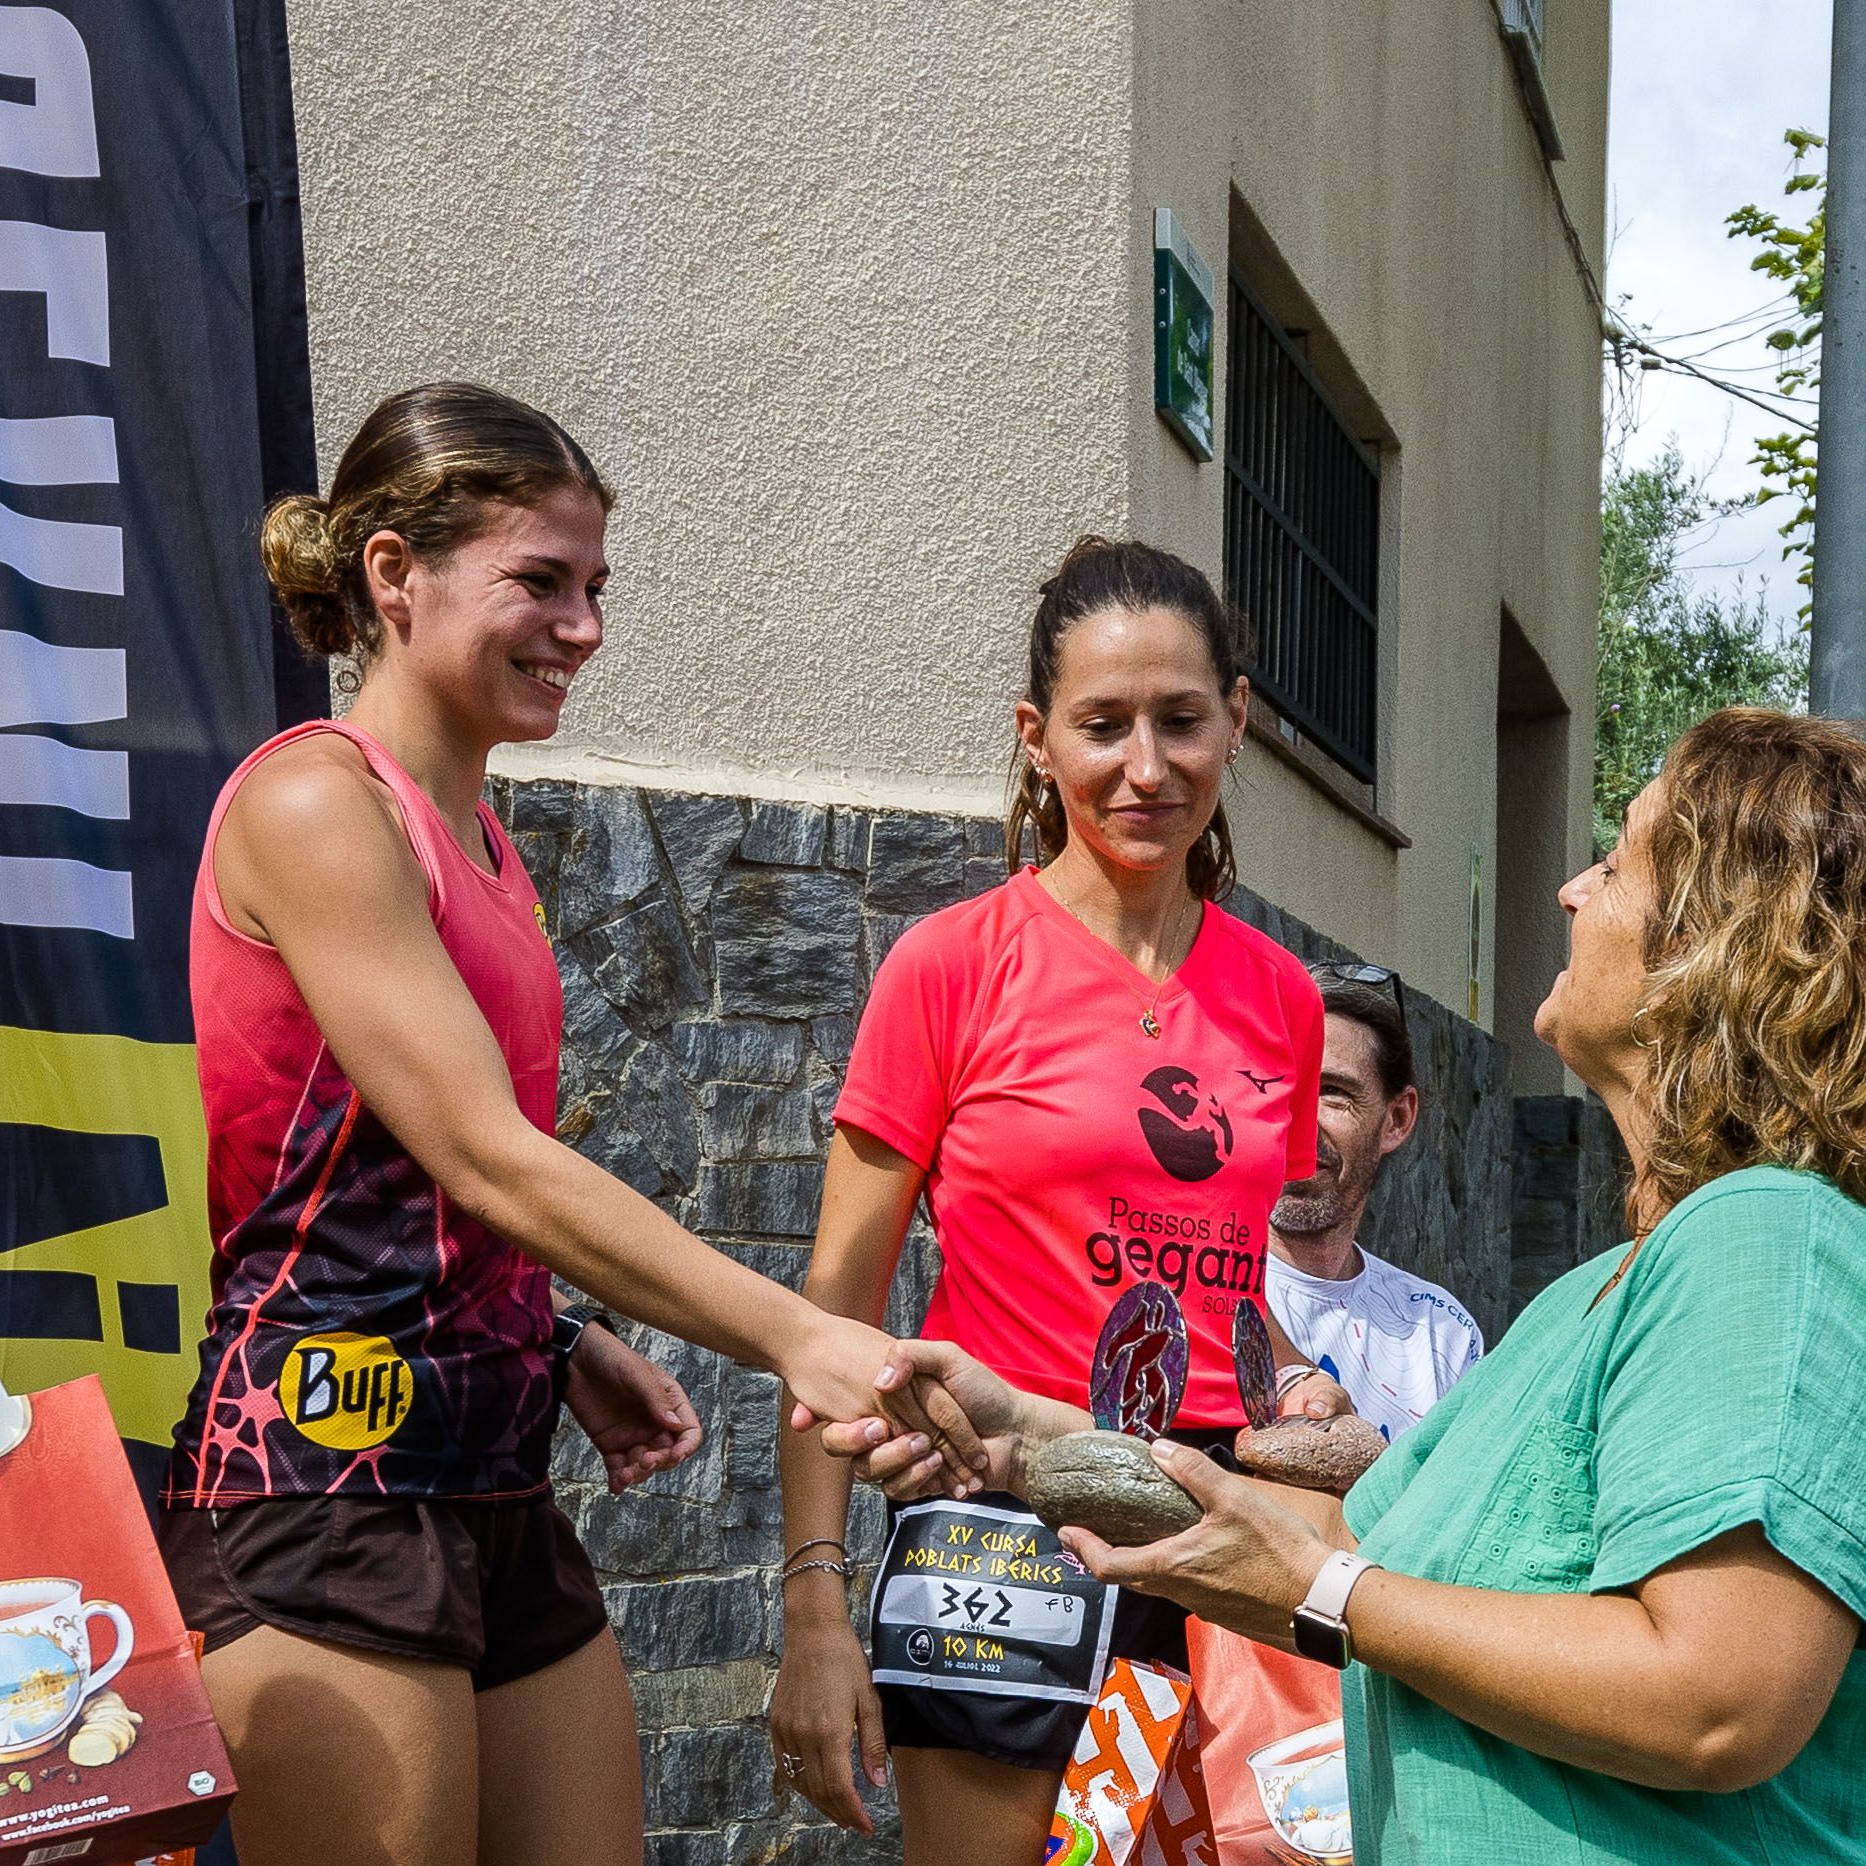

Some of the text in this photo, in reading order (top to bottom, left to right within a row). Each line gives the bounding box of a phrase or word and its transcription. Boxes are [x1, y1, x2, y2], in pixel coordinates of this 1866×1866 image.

[1108, 1196, 1250, 1246] Passos de
[1409, 1293, 1445, 1308] CIMS
[947, 1525, 1038, 1558] XV CURSA
[905, 1548, 982, 1575] POBLATS
[937, 1582, 1013, 1628] 362
[943, 1635, 1005, 1660] 10 KM
[980, 1663, 1001, 1674] 2022
[0, 1805, 130, 1842] www.facebook.com/yogitea
